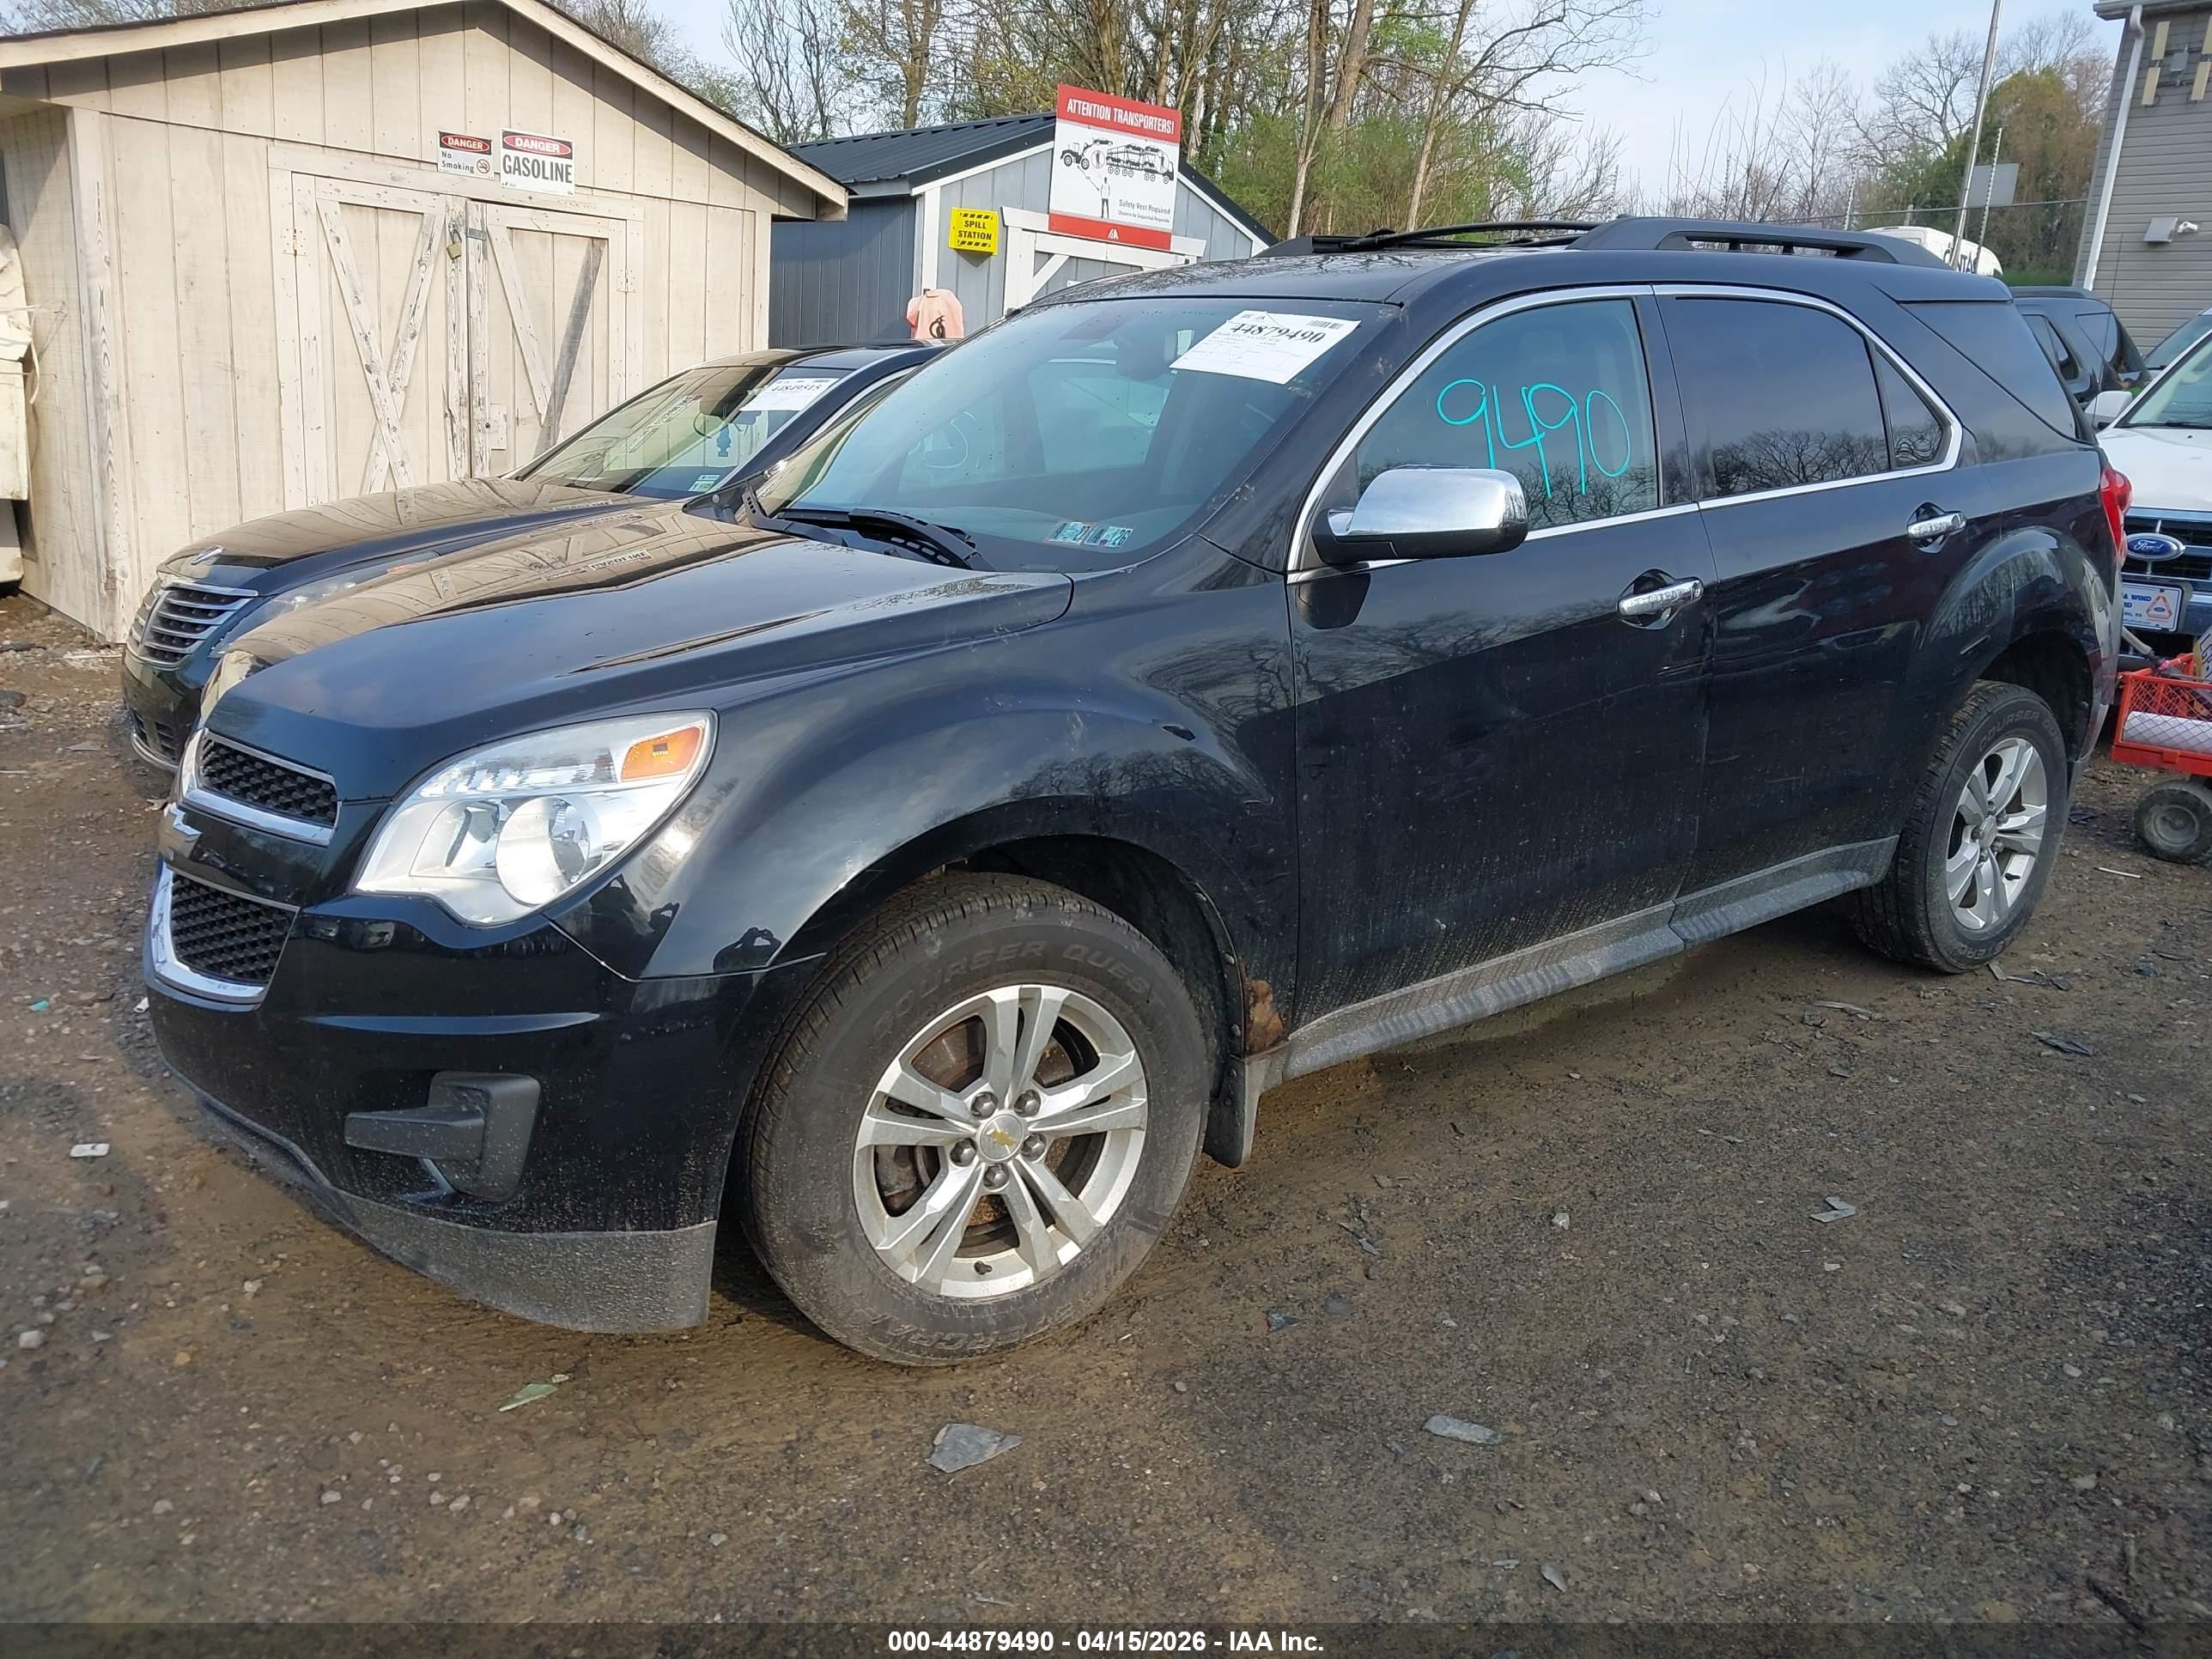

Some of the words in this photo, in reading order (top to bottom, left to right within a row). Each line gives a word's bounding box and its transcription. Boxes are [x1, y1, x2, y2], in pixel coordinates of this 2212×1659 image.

[1066, 98, 1111, 121] ATTENTION
[1113, 108, 1175, 134] TRANSPORTERS!
[447, 137, 483, 150] DANGER
[514, 137, 560, 153] DANGER
[441, 161, 474, 174] Smoking
[502, 154, 573, 184] GASOLINE
[1119, 199, 1135, 210] Safety
[1148, 204, 1170, 215] Required
[964, 220, 987, 229] SPILL
[957, 230, 992, 240] STATION
[1231, 323, 1327, 343] 44879490
[1436, 379, 1631, 499] 9490
[2133, 539, 2164, 553] Ford
